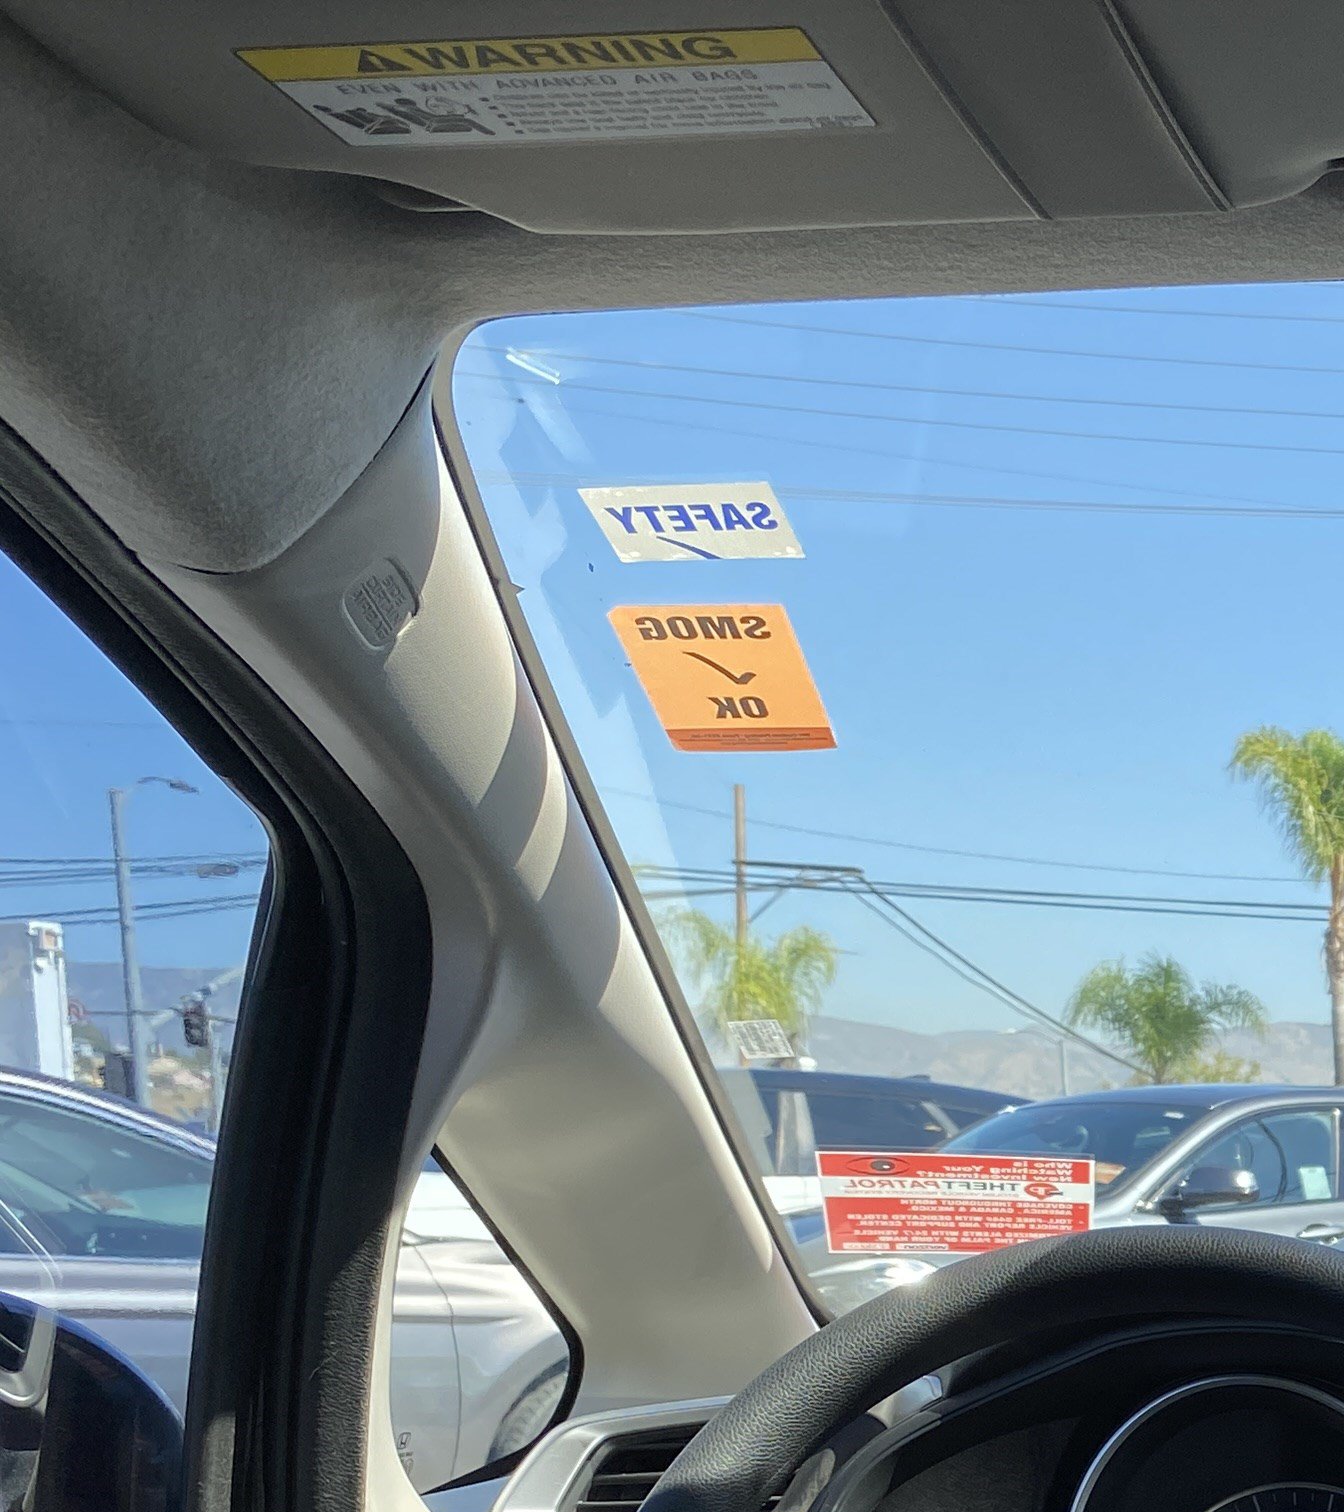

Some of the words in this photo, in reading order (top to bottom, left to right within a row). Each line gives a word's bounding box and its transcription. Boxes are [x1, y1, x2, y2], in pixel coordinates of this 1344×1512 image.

[405, 35, 739, 71] WARNING
[335, 82, 401, 97] EVEN
[413, 78, 480, 94] WITH
[494, 74, 618, 91] ADVANCED
[632, 71, 677, 85] AIR
